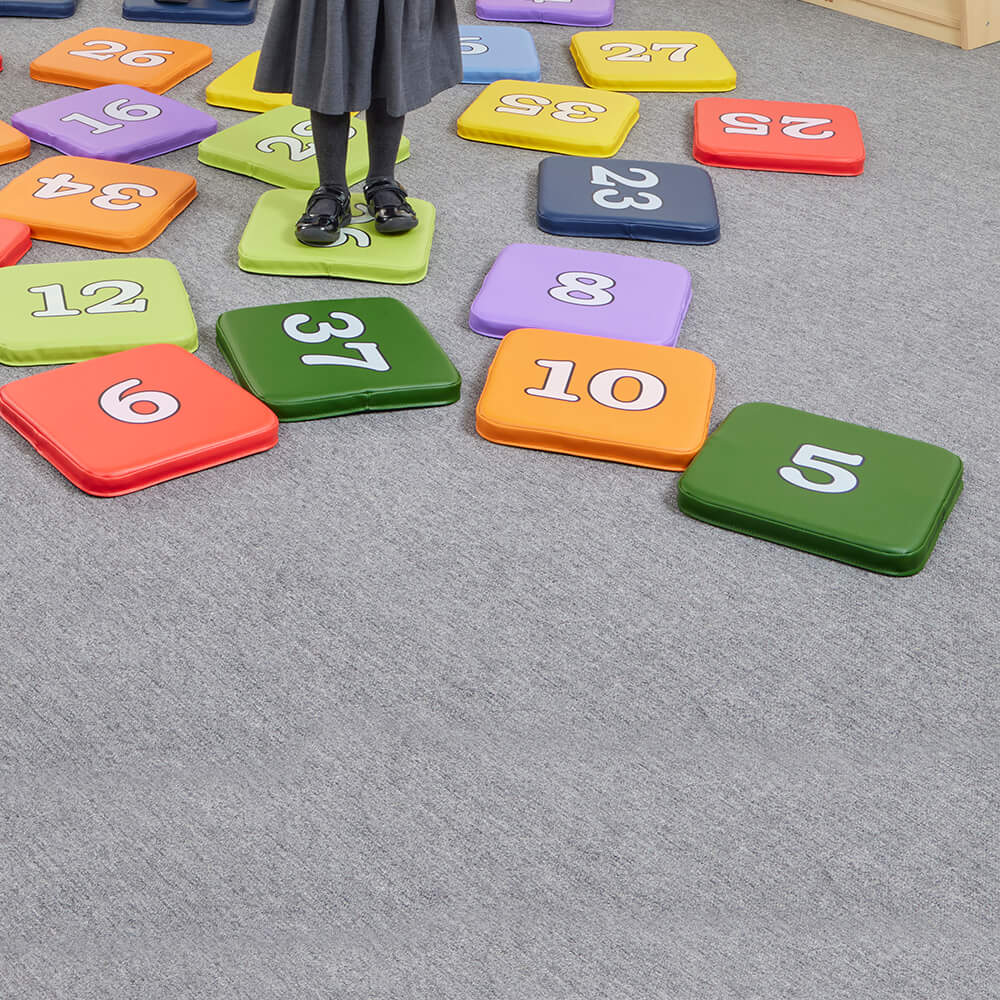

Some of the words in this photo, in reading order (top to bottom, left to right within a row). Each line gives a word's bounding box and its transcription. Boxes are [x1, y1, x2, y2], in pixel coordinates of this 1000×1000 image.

[68, 39, 174, 68] 26
[600, 41, 698, 63] 27
[59, 98, 162, 135] 16
[494, 93, 607, 124] 35
[719, 111, 835, 141] 25
[32, 172, 157, 212] 34
[589, 164, 664, 212] 23
[28, 279, 147, 318] 12
[548, 270, 615, 307] 8
[282, 310, 391, 373] 37
[525, 358, 666, 412] 10
[778, 443, 865, 494] 5
